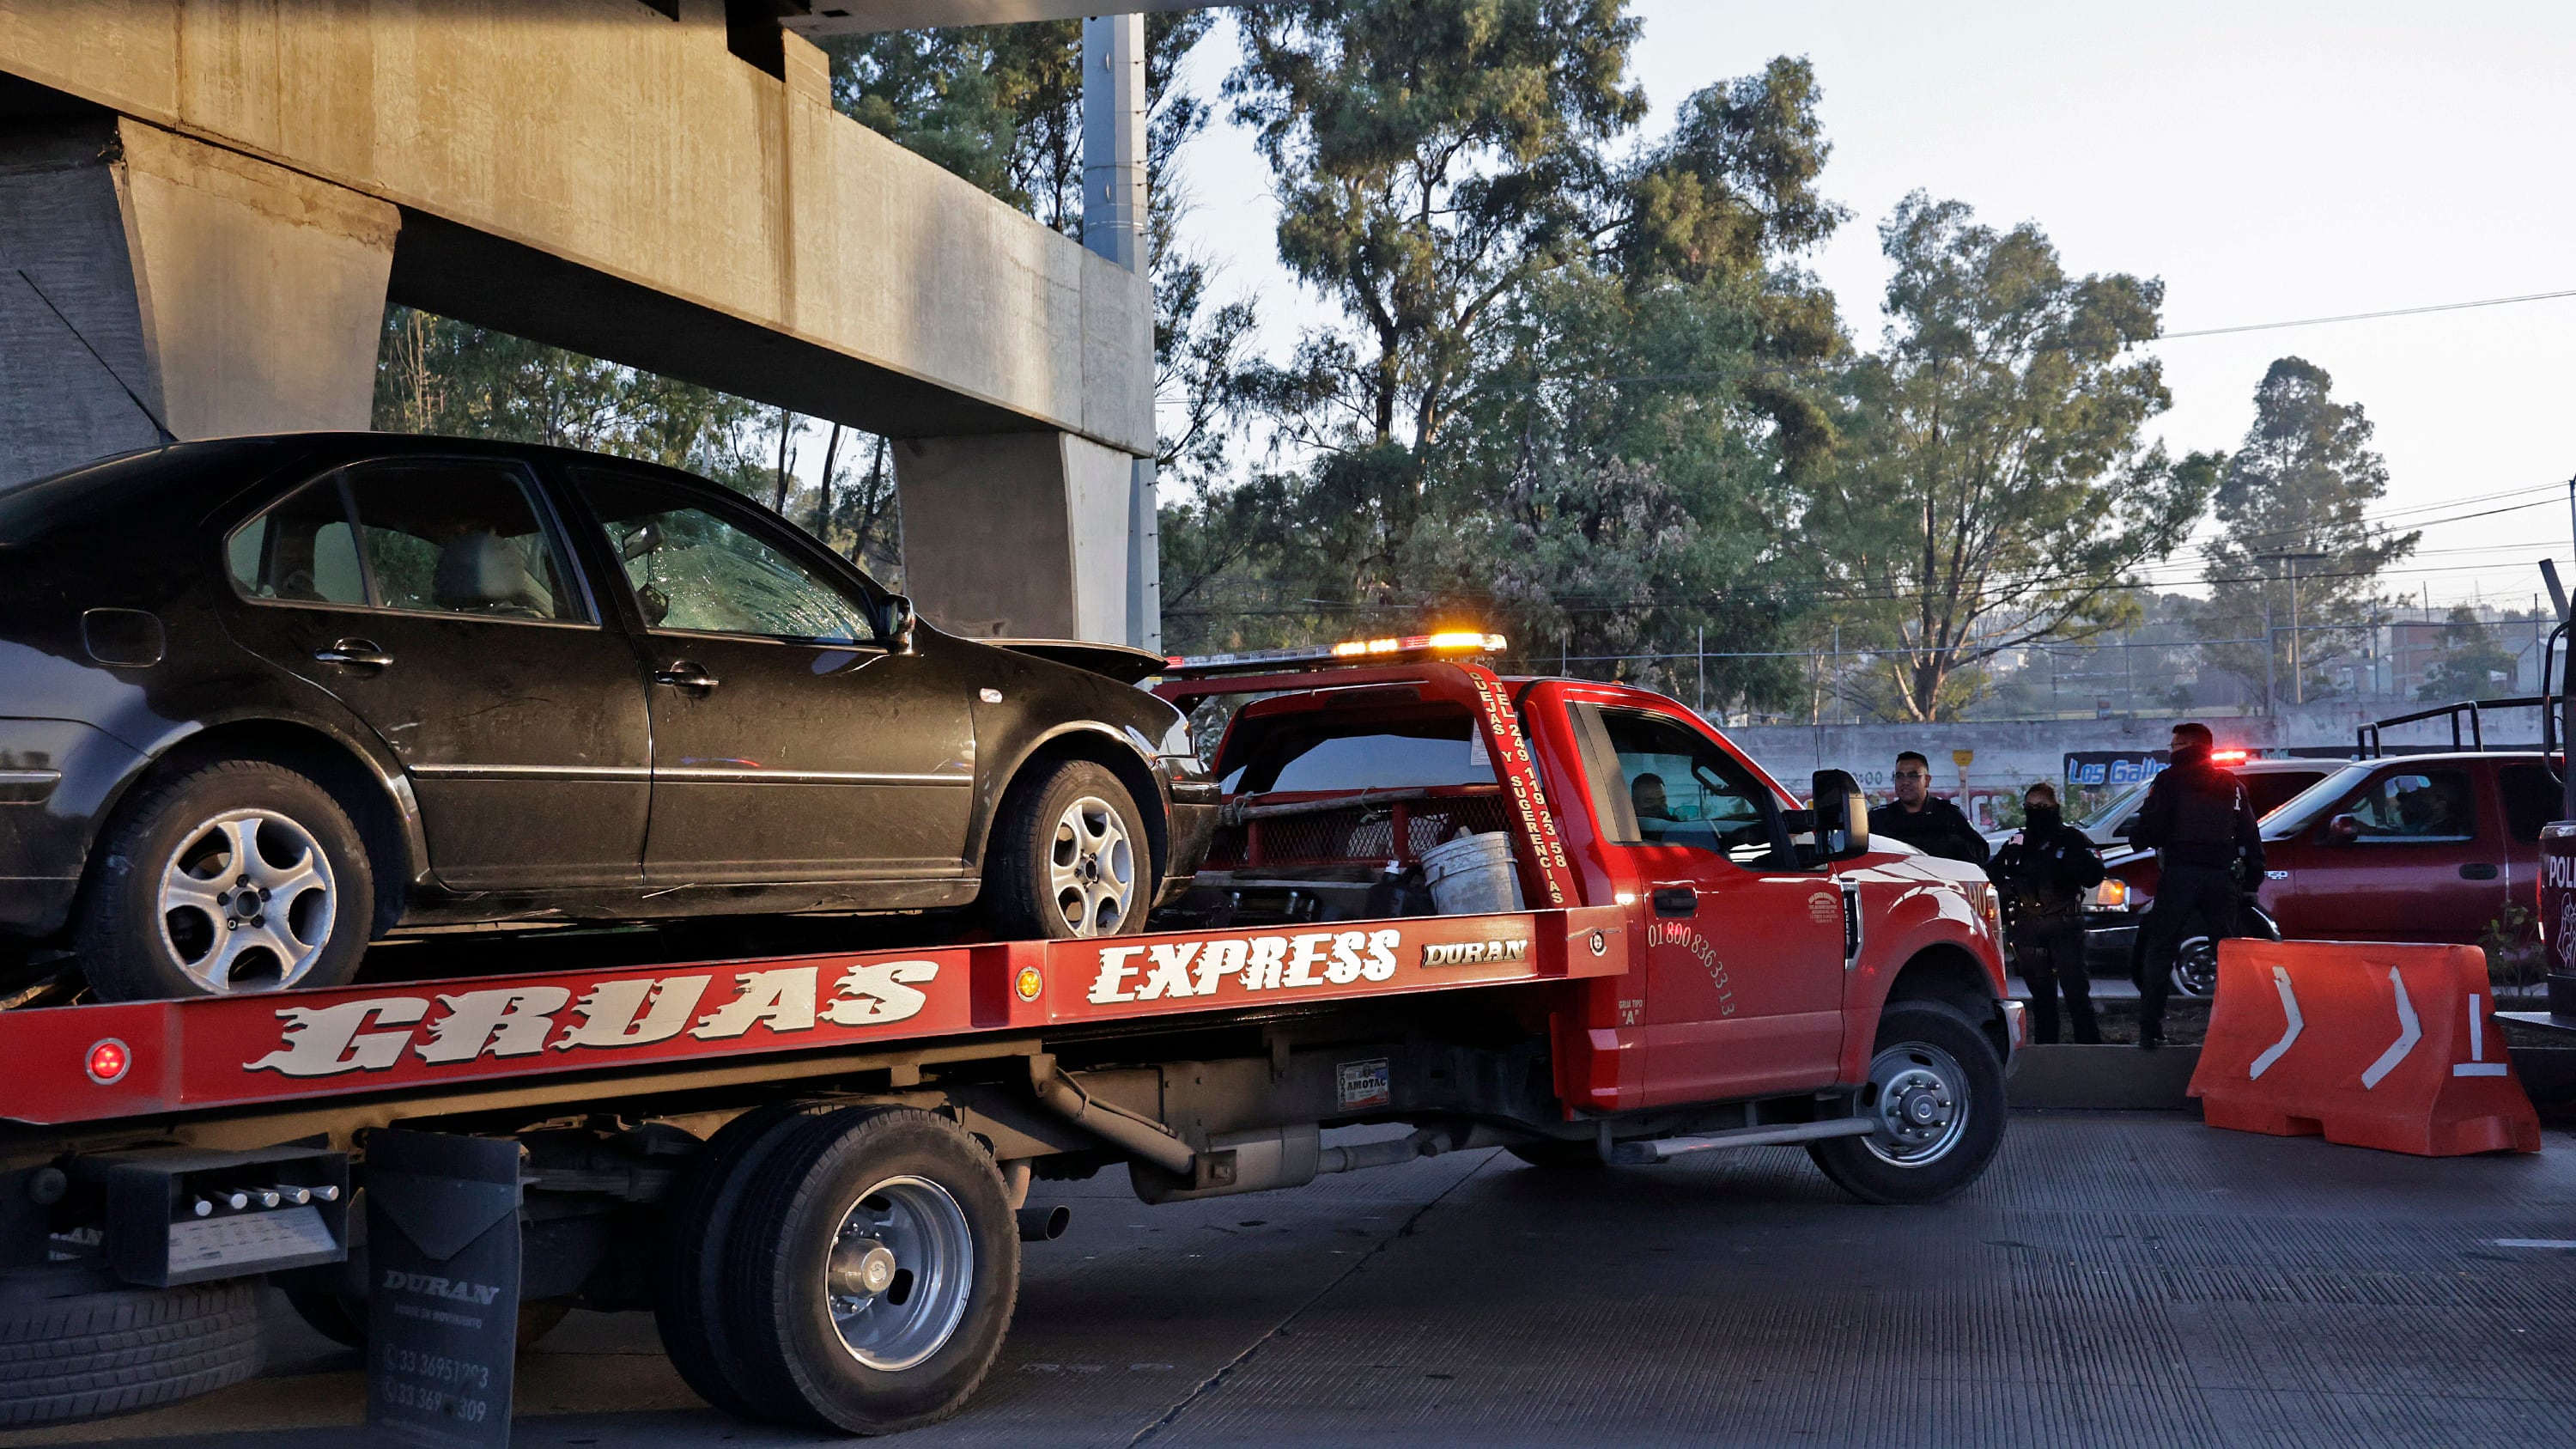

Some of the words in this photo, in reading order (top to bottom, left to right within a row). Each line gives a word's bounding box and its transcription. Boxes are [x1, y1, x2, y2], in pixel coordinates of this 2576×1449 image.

[1491, 681, 1516, 719] TEL
[1510, 725, 1529, 762] 249
[1525, 767, 1545, 806] 119
[1543, 810, 1556, 836] 23
[1551, 842, 1566, 868] 58
[2068, 757, 2106, 785] Los
[1468, 671, 1505, 735] QUEJAS
[1502, 751, 1513, 763] Y
[1510, 775, 1564, 904] SUGERENCIAS
[1968, 882, 1987, 916] 90
[1649, 923, 1663, 947] 01
[1667, 921, 1691, 948] 800
[1086, 928, 1401, 1004] EXPRESS
[1422, 939, 1528, 968] DURAN
[1691, 934, 1716, 968] 836
[1710, 961, 1728, 989] 33
[1619, 1000, 1631, 1009] GRUA
[1631, 999, 1643, 1008] TIPO
[1718, 989, 1735, 1016] 13
[242, 960, 939, 1077] GRUAS
[1347, 1078, 1387, 1091] AMOTAC
[383, 1269, 500, 1305] DURAN
[417, 1387, 487, 1422] 369309
